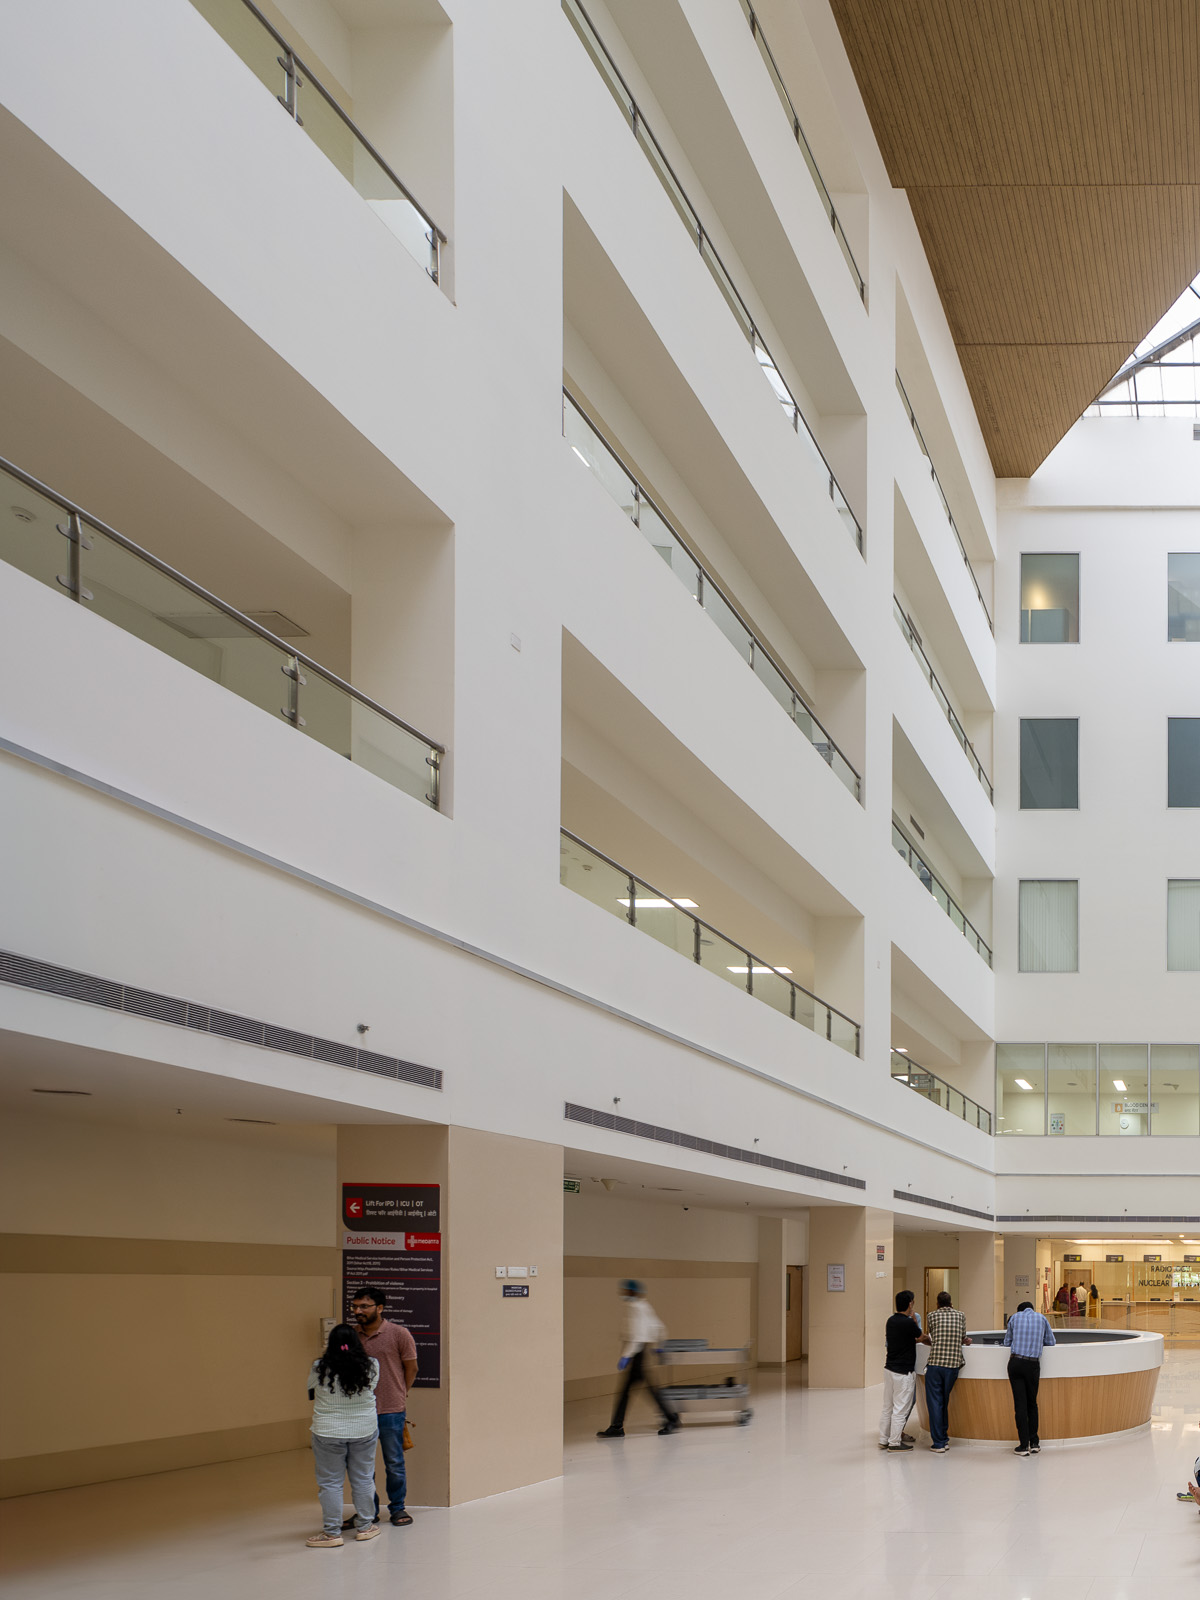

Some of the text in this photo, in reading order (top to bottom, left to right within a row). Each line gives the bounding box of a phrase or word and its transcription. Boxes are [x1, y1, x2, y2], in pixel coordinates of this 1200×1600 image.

[346, 1236, 396, 1245] Public Notice
[1138, 1279, 1170, 1287] NUCLEAR
